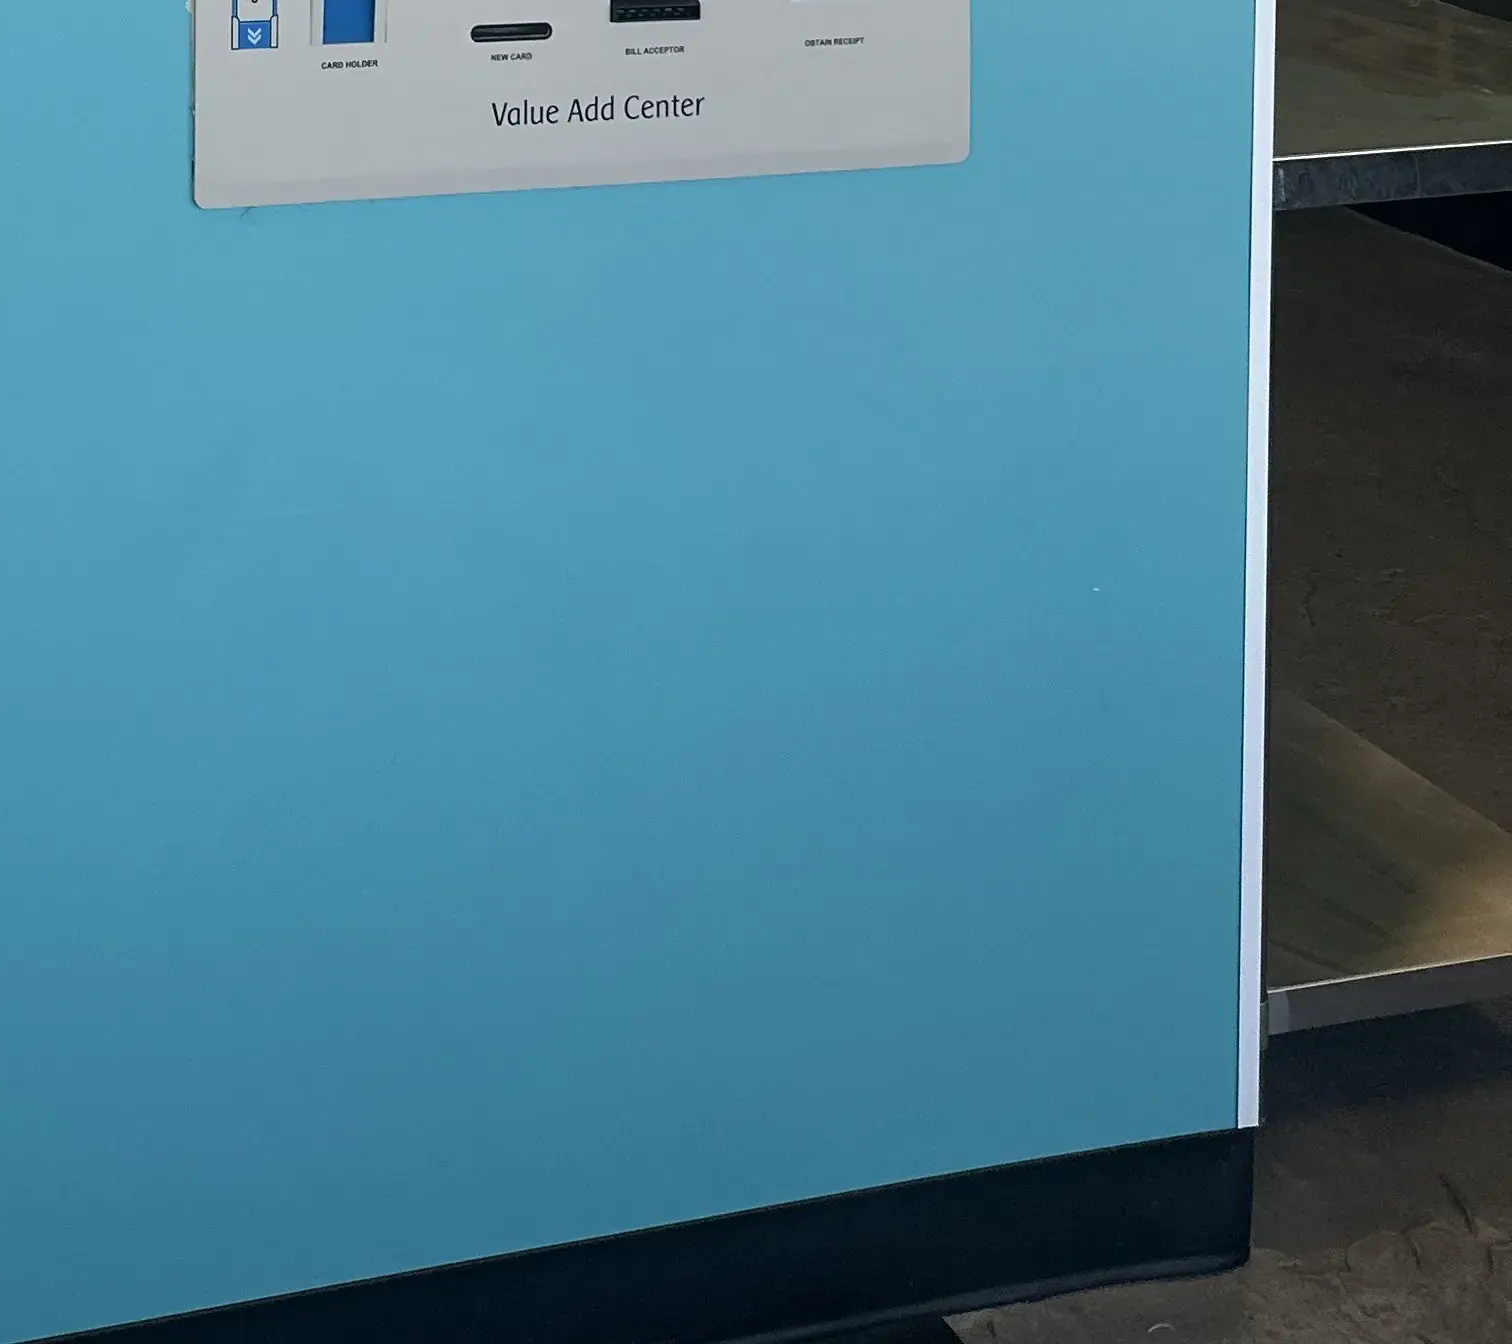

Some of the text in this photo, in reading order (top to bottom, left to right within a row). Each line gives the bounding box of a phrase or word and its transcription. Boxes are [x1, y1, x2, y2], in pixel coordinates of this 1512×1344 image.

[491, 94, 705, 127] Value Add Center
